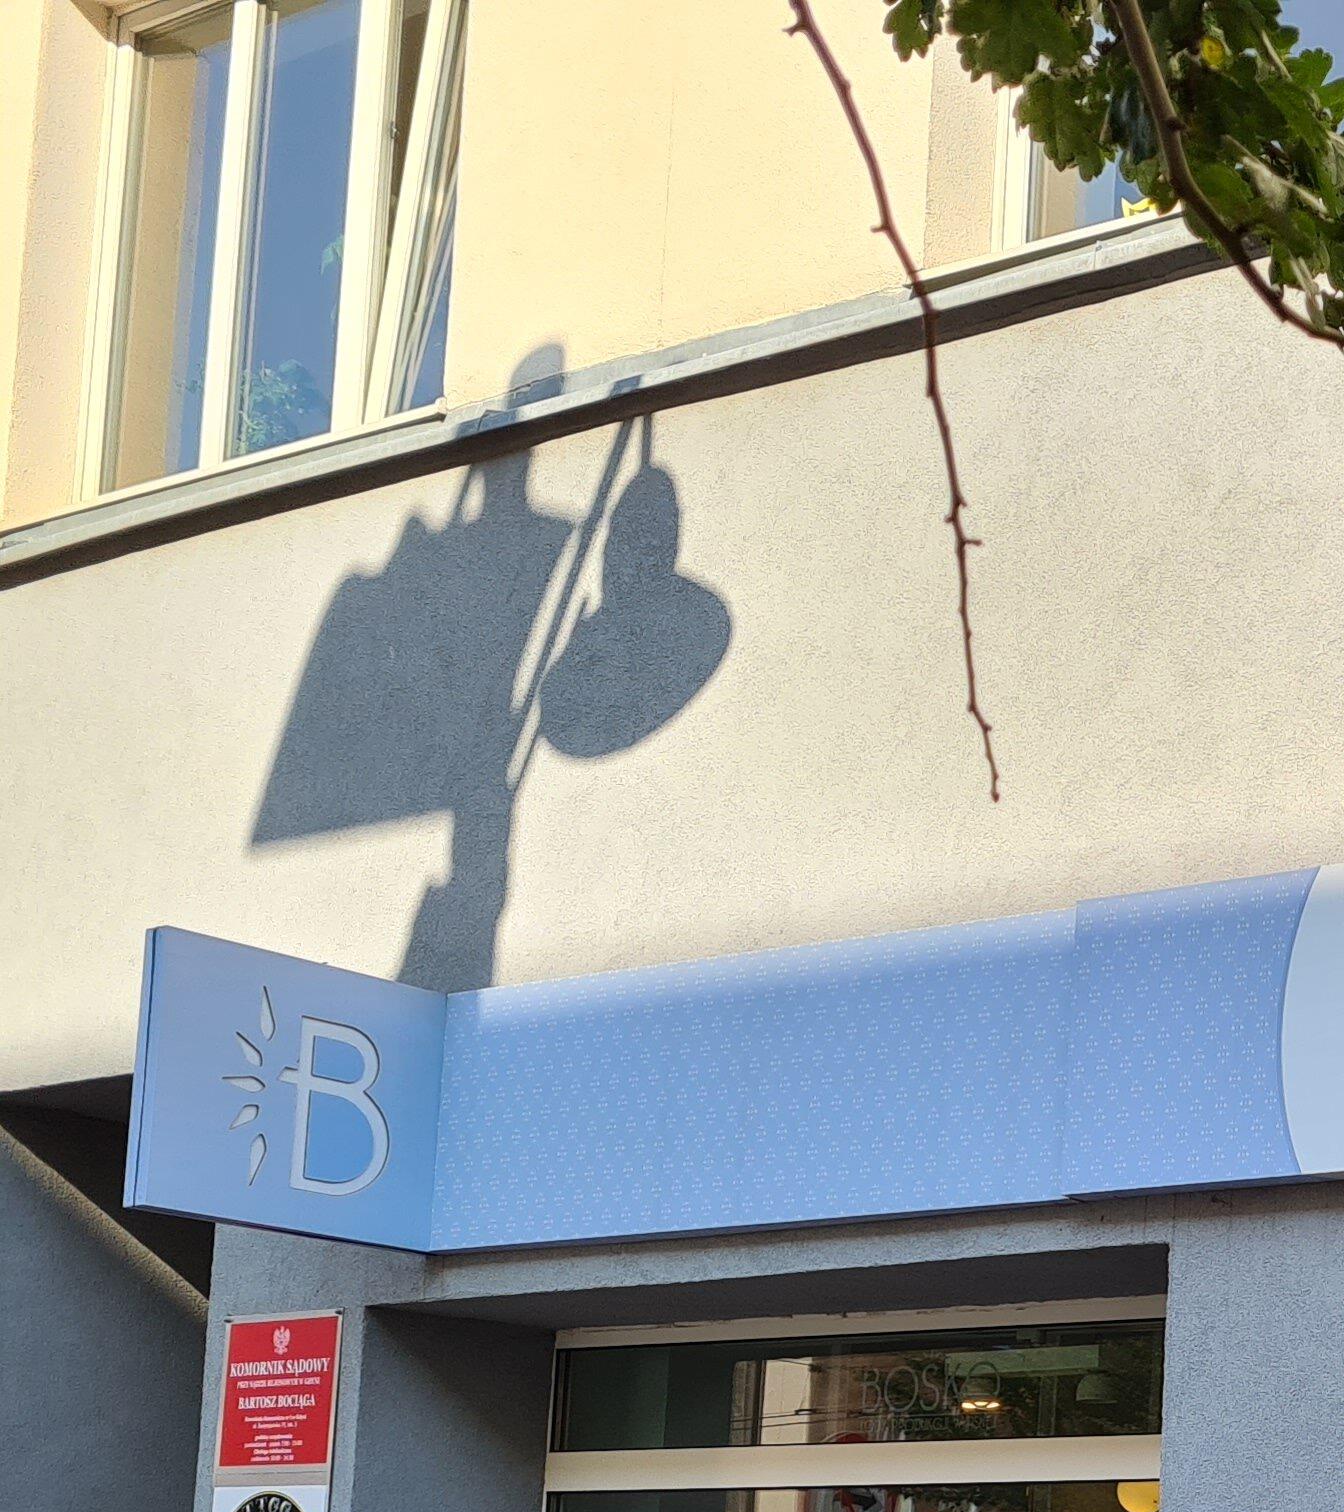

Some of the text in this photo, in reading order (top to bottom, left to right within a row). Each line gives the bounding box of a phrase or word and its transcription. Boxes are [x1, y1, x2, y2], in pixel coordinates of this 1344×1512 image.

[229, 1357, 331, 1378] KOMORNIK SĄDOWY
[238, 1393, 316, 1410] BARTOSZ BOCIĄGA
